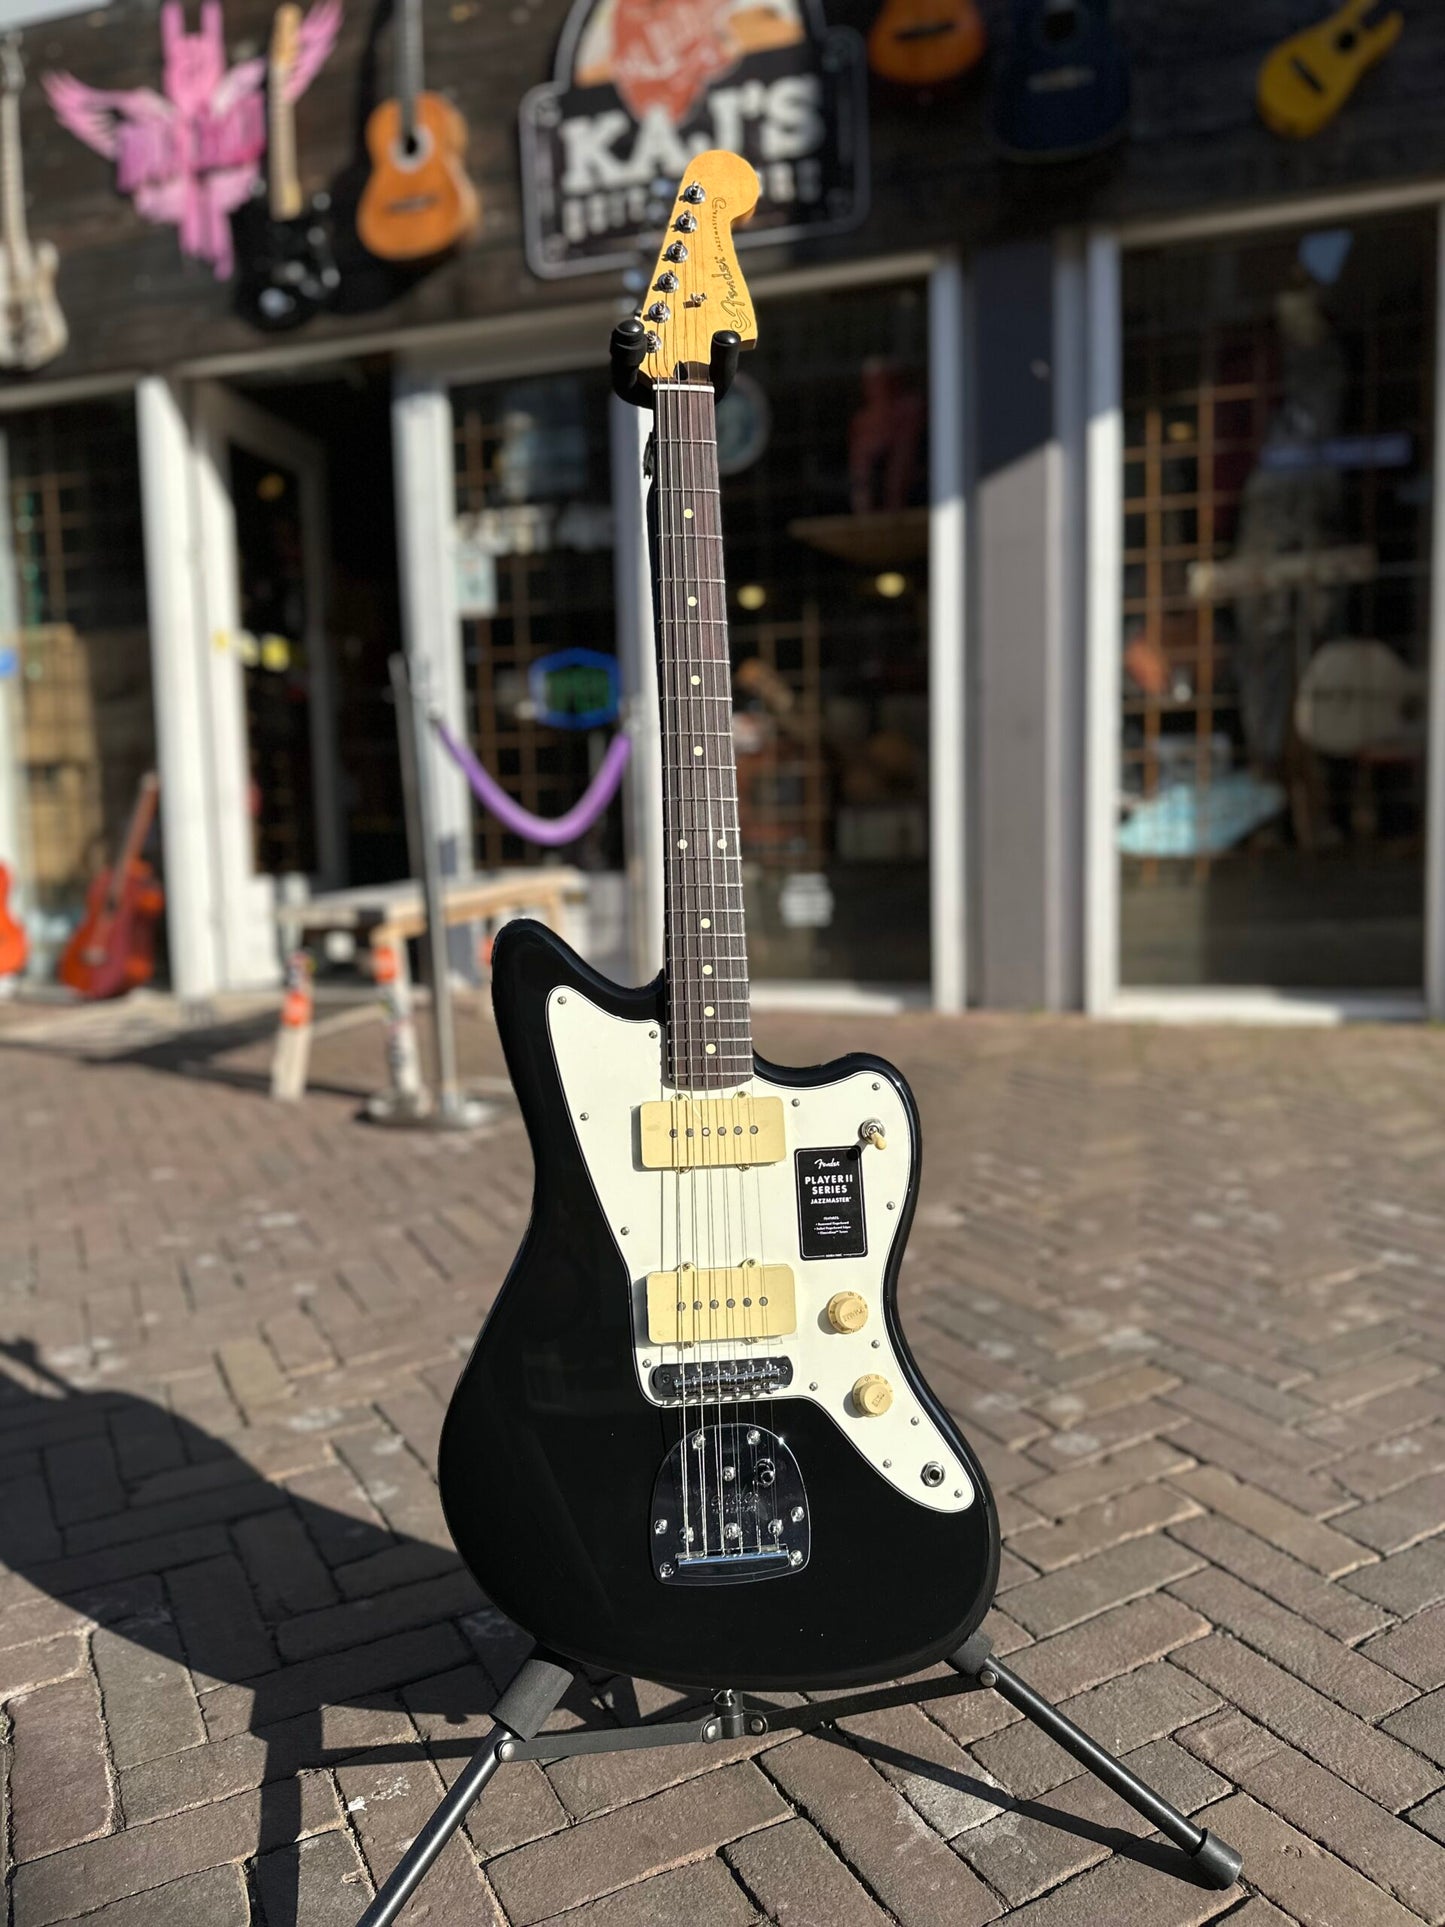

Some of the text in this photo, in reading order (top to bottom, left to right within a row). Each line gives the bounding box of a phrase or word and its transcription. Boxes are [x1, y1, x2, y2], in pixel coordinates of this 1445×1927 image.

[558, 75, 824, 195] KAJ'S
[711, 256, 745, 316] Fender
[814, 1158, 840, 1169] Fender
[805, 1174, 853, 1185] PLAYER II
[812, 1185, 847, 1195] SERIES
